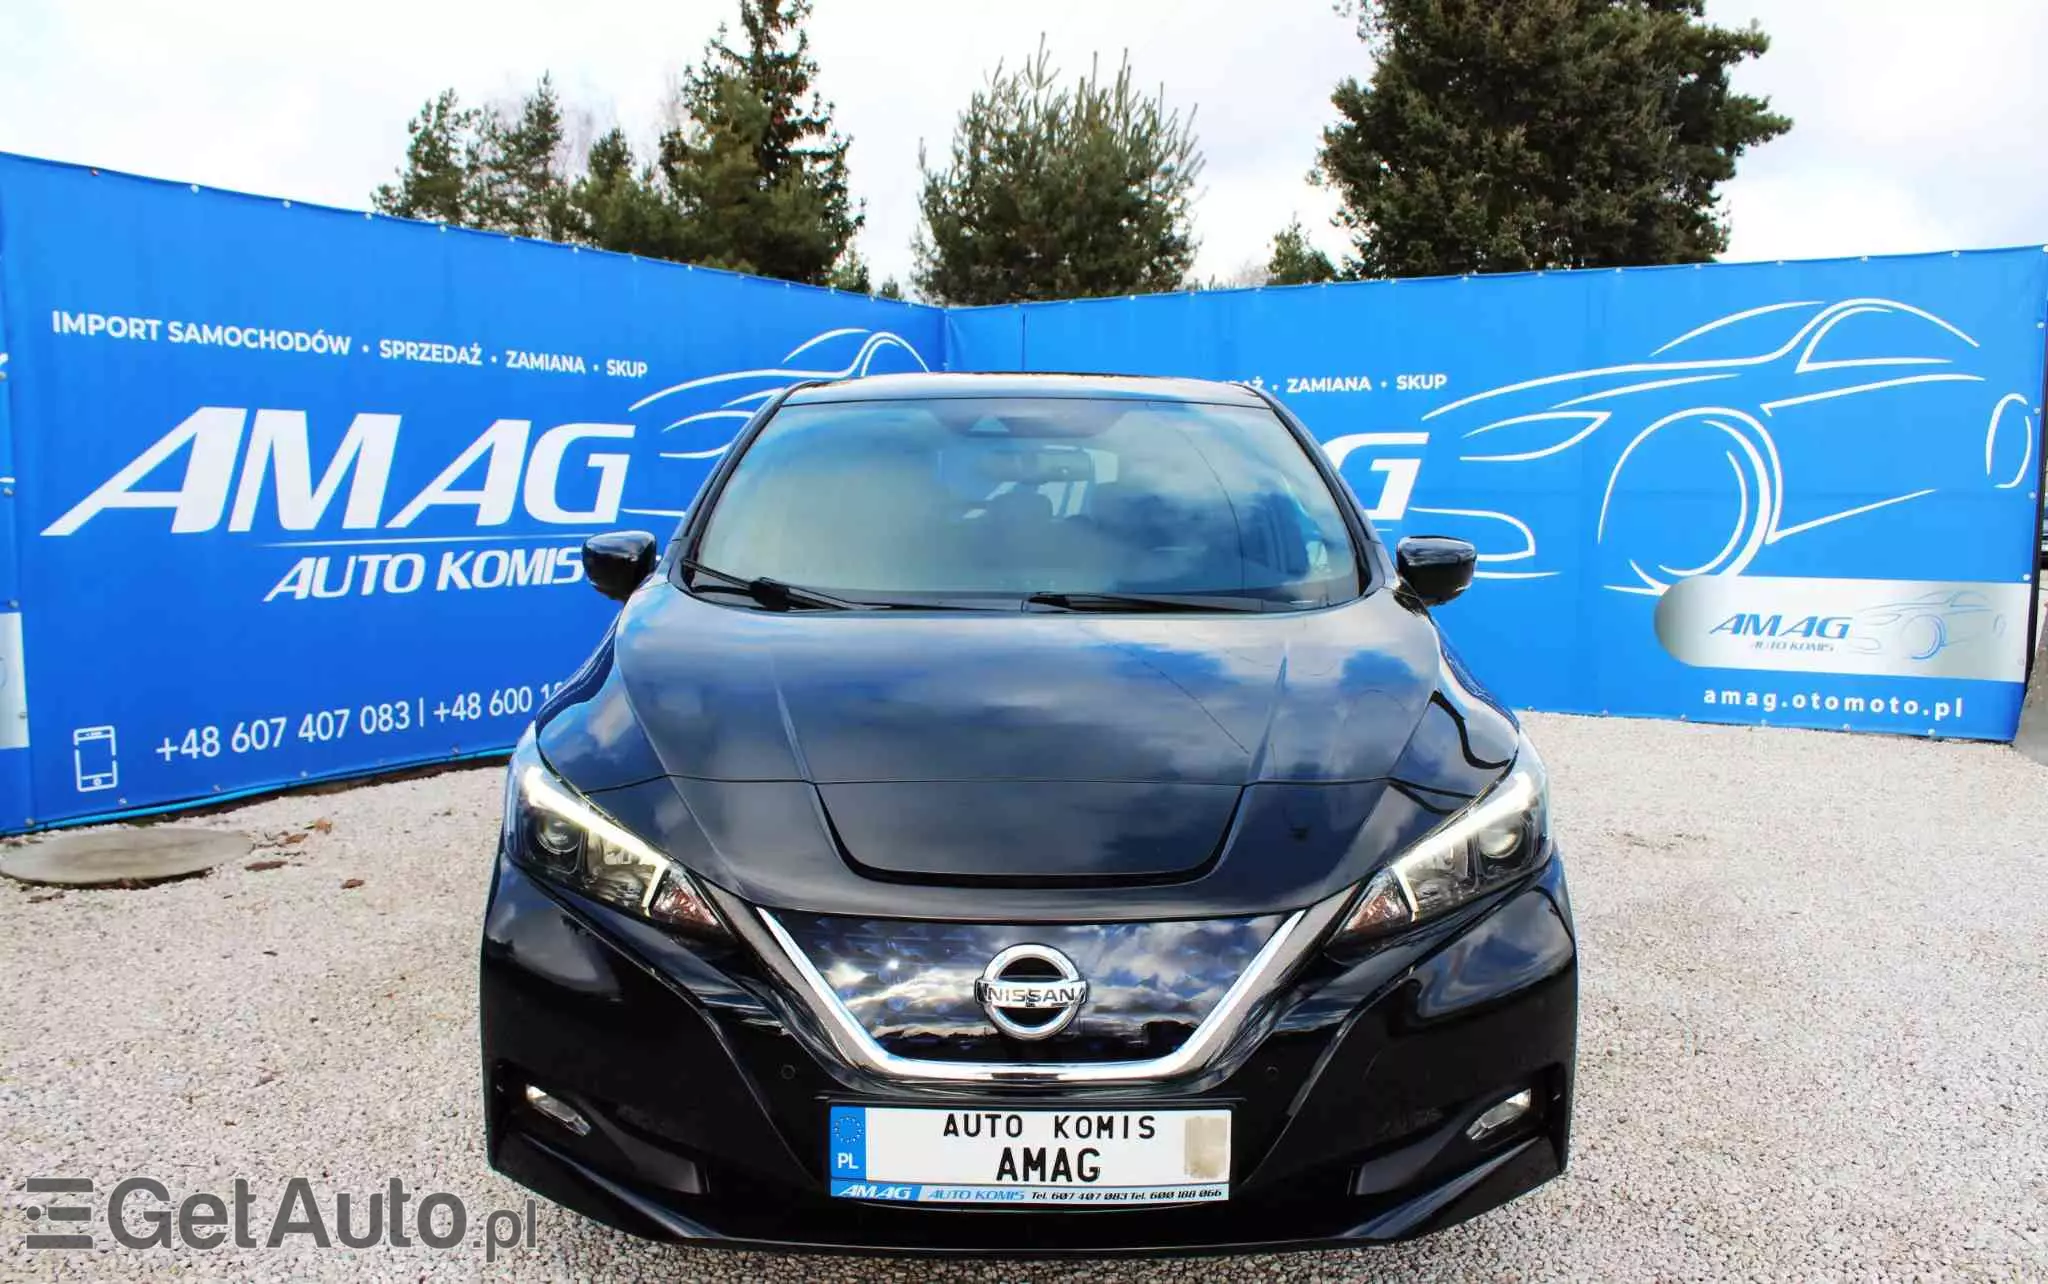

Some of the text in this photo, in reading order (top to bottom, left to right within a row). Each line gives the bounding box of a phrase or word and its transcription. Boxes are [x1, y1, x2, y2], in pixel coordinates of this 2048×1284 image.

[52, 310, 648, 379] IMPORT SAMOCHODÓW SPRZEDAŻ ZAMIANA SKUP
[1286, 373, 1448, 393] ZAMIANA SKUP
[263, 547, 585, 602] AUTO KOMIS
[1703, 687, 1963, 720] amag.otomoto.pl
[156, 725, 220, 761] +48
[231, 718, 287, 753] 607
[298, 709, 350, 742] 407
[360, 702, 410, 735] 083
[434, 692, 482, 722] +48
[489, 685, 533, 717] 600
[988, 988, 1074, 1002] NISSAN
[943, 1113, 1156, 1140] AUTO KOMIS
[837, 1152, 859, 1170] PL
[996, 1147, 1101, 1183] AMAG
[928, 1190, 972, 1201] AUTO
[974, 1190, 1025, 1201] KOMIS
[1051, 1191, 1074, 1200] 607
[1079, 1191, 1101, 1200] 407
